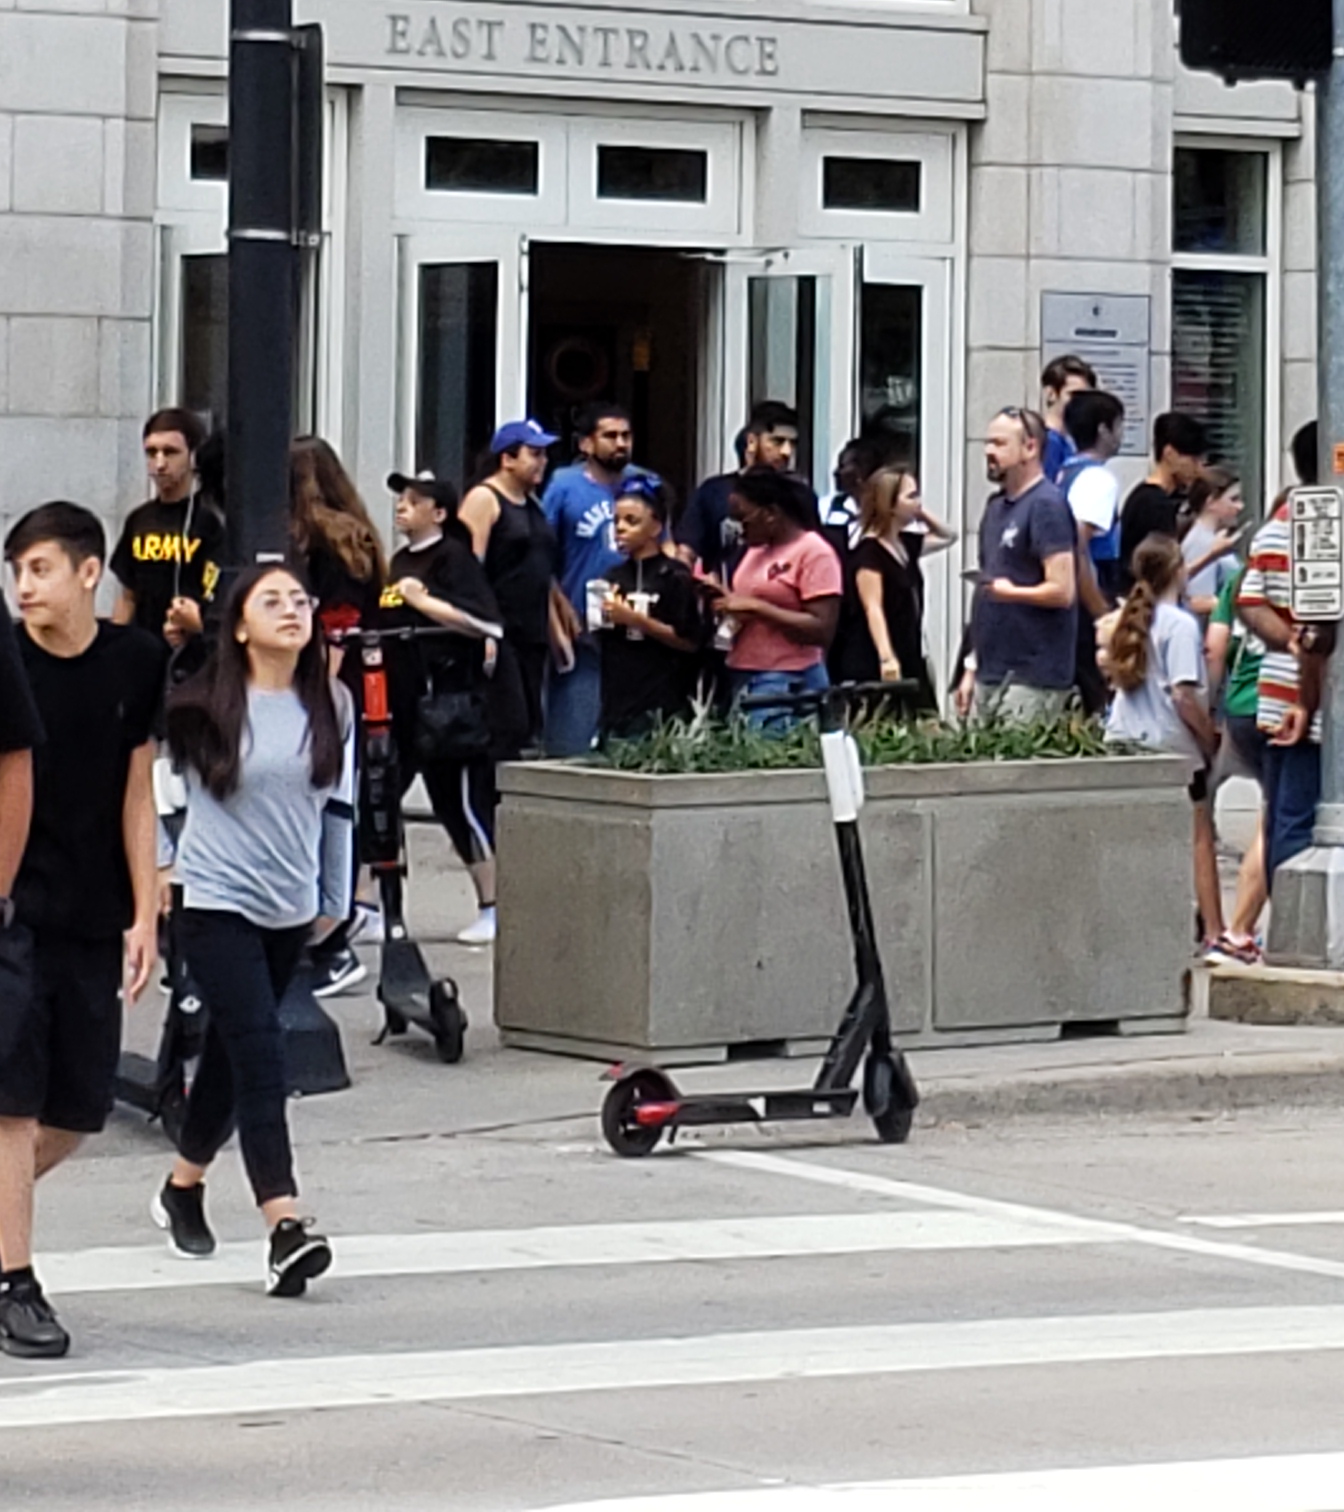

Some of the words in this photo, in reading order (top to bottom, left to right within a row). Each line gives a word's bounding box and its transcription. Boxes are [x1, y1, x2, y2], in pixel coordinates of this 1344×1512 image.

[385, 14, 505, 62] EAST
[526, 22, 780, 76] ENTRANCE
[132, 534, 201, 564] ARMY
